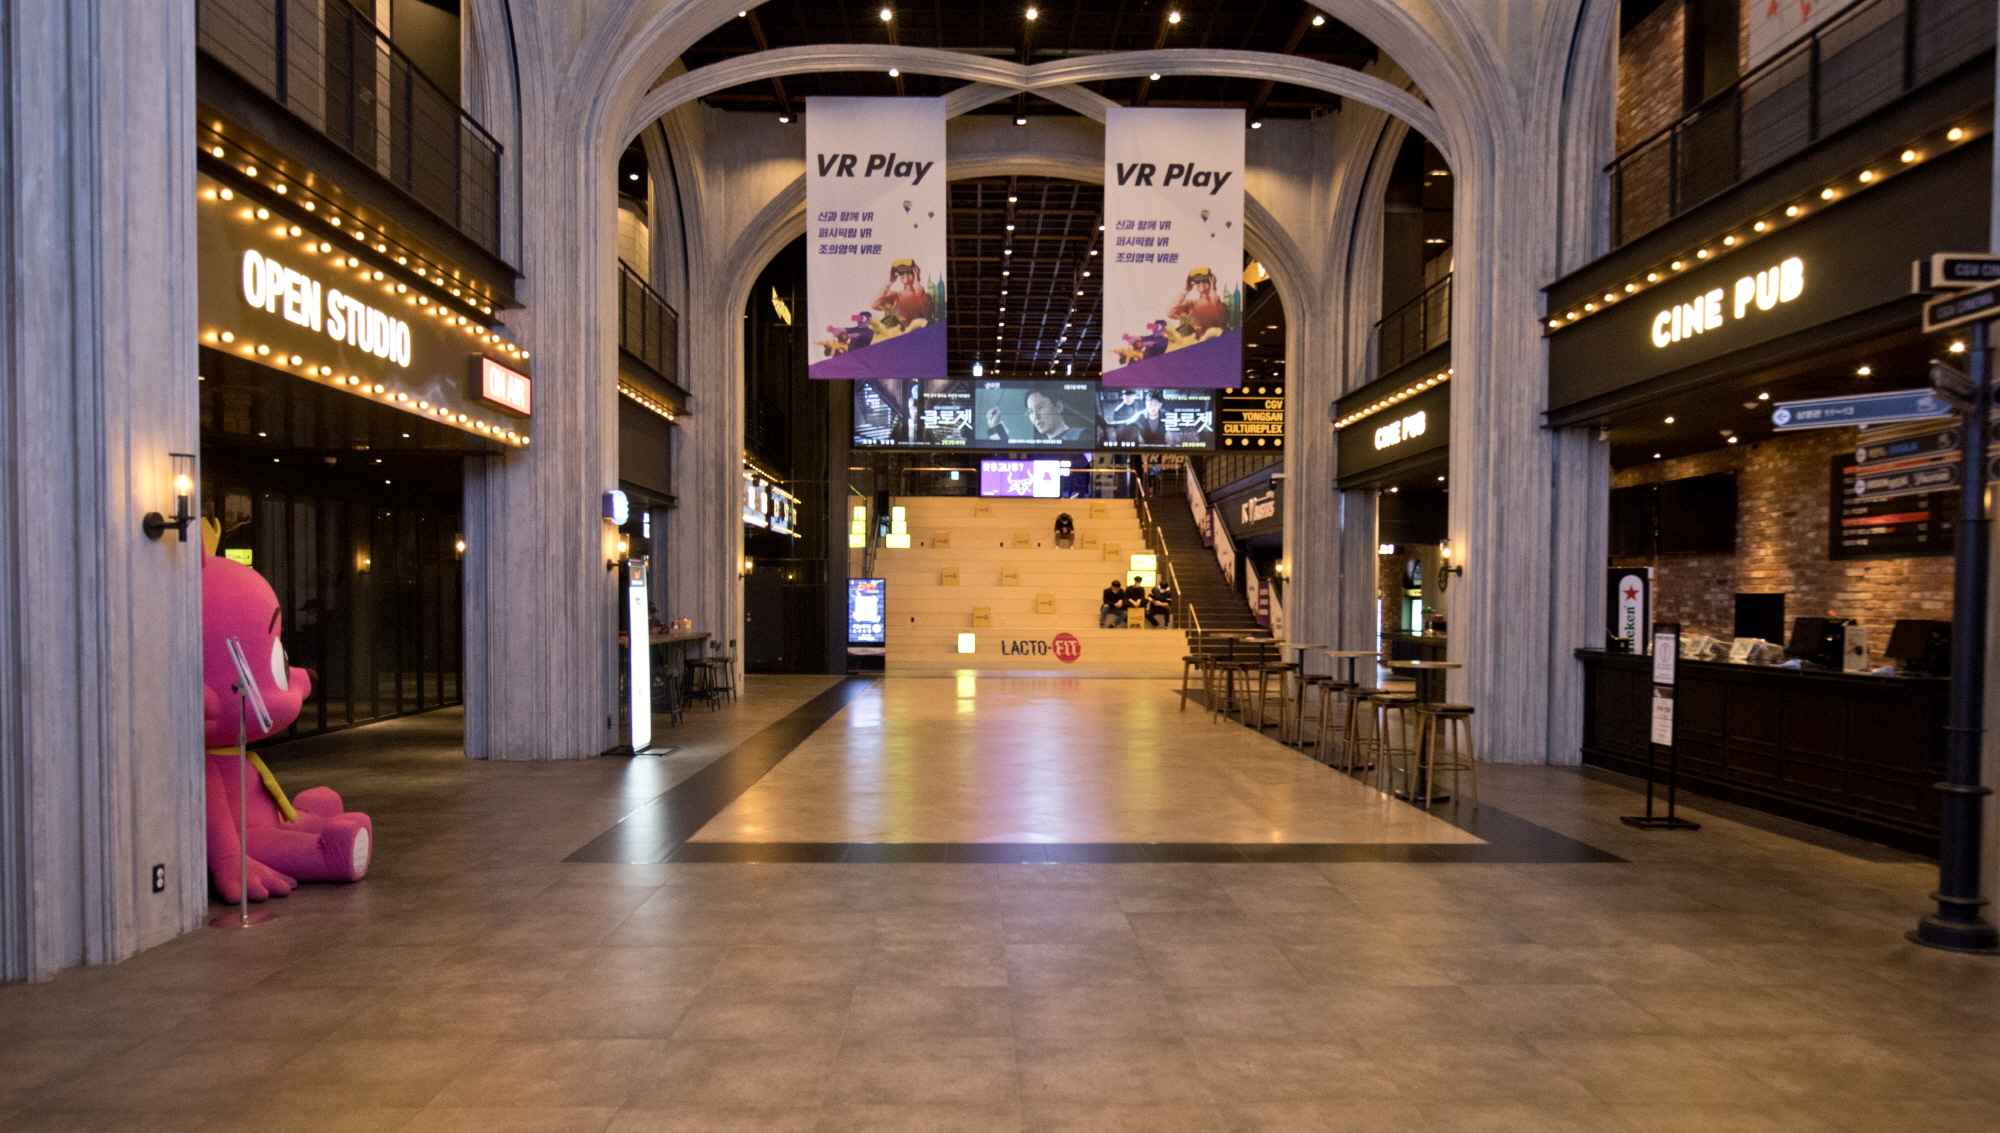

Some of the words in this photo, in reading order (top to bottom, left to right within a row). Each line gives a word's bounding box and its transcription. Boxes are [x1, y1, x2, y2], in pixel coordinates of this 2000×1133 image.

[816, 153, 857, 177] VR
[865, 153, 934, 185] Play
[1116, 163, 1156, 187] VR
[1163, 162, 1233, 195] Play
[818, 211, 838, 222] 신과
[840, 211, 860, 222] 함께
[862, 211, 874, 222] VR
[1115, 220, 1135, 230] 신과
[1137, 220, 1157, 230] 함께
[1159, 220, 1171, 231] VR
[860, 228, 872, 239] VR
[1157, 237, 1169, 247] VR
[818, 244, 858, 255] 조의영역
[242, 248, 322, 332] OPEN
[326, 288, 411, 367] STUDIO
[1651, 287, 1724, 348] CINE
[1734, 256, 1804, 320] PUB
[489, 366, 506, 401] ON
[507, 375, 525, 409] AIR
[1264, 399, 1283, 410] CGV
[920, 408, 973, 430] 클로젯
[1160, 410, 1214, 433] 클로젯
[1242, 411, 1283, 422] YONGSAN
[1223, 424, 1283, 434] CULTUREPLEX
[1374, 420, 1401, 450] CINE
[1401, 410, 1426, 441] PUB
[1001, 638, 1080, 658] LACTO-FIT
